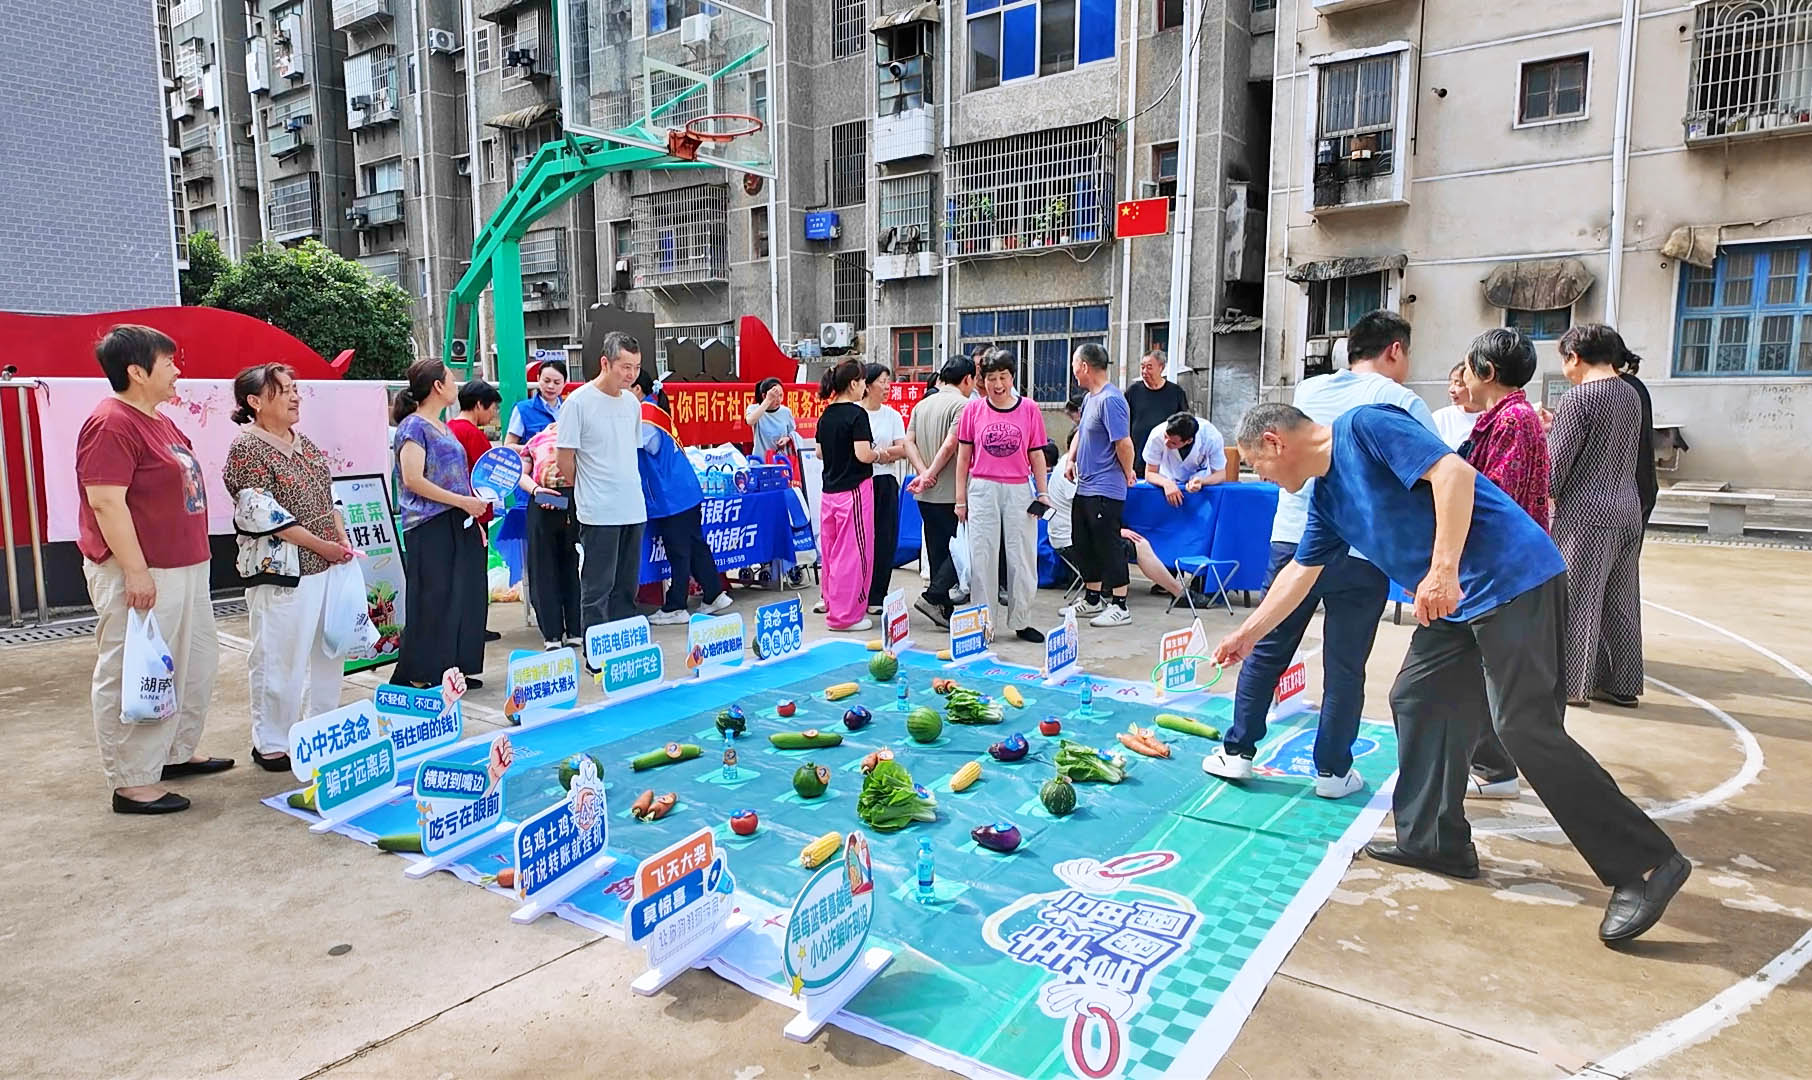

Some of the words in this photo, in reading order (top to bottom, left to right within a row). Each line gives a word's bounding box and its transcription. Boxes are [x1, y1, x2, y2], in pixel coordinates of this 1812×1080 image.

[345, 523, 391, 547] 好礼
[763, 604, 799, 630] 贪念一起
[591, 625, 648, 656] 防范电信诈骗
[611, 652, 658, 683] 保护财产安全
[297, 714, 371, 763] 心中无贪念
[325, 748, 391, 798] 骗子远离身
[423, 768, 486, 792] 横财到嘴边
[429, 792, 500, 842] 吃亏在眼前
[522, 820, 603, 889] 听说转账就挂机
[650, 843, 706, 888] 飞天大奖
[811, 904, 868, 968] 小心诈骗听到没
